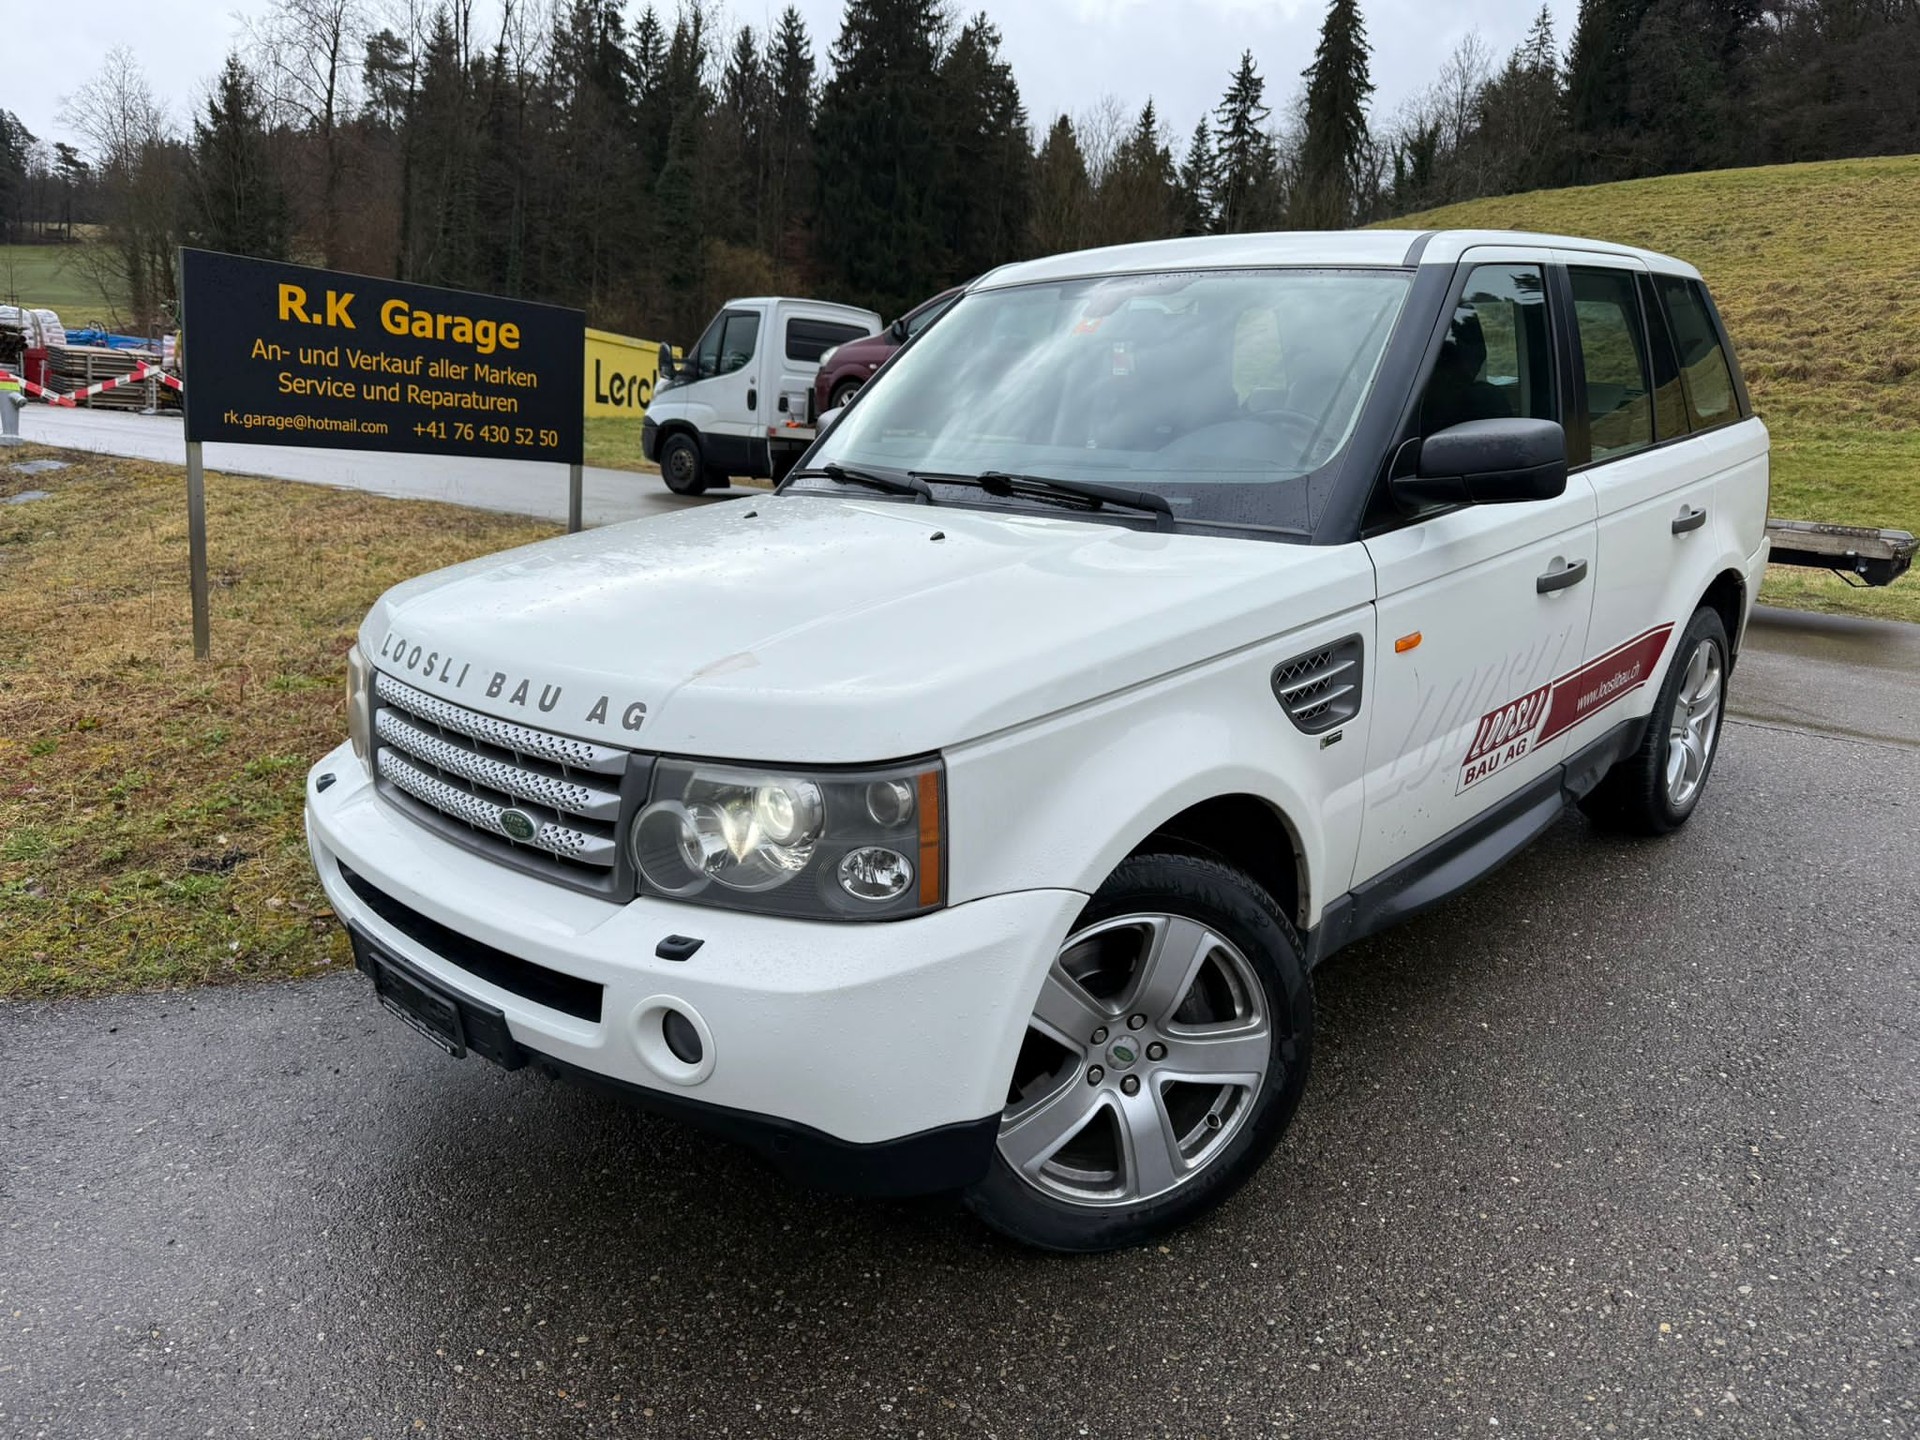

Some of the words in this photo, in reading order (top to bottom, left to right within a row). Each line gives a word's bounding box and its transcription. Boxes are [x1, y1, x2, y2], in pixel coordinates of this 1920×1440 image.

[278, 283, 357, 330] R.K
[380, 298, 521, 355] Garage
[251, 338, 291, 361] An-
[299, 347, 339, 368] und
[346, 348, 423, 376] Verkauf
[428, 358, 468, 380] aller
[474, 363, 538, 388] Marken
[278, 371, 356, 399] Service
[363, 382, 400, 403] und
[407, 384, 519, 413] Reparaturen
[223, 409, 389, 434] rk.garage@hotmail.com
[412, 420, 448, 439] +41
[453, 422, 475, 441] 76
[479, 425, 510, 443] 430
[515, 427, 534, 445] 52
[539, 430, 559, 447] 50
[381, 633, 470, 688] LOOSLI
[485, 671, 562, 713] BAU
[585, 695, 647, 732] AG
[1576, 661, 1641, 711] www.looslibau.ch
[1464, 753, 1500, 785] BAU
[1504, 737, 1527, 763] AG
